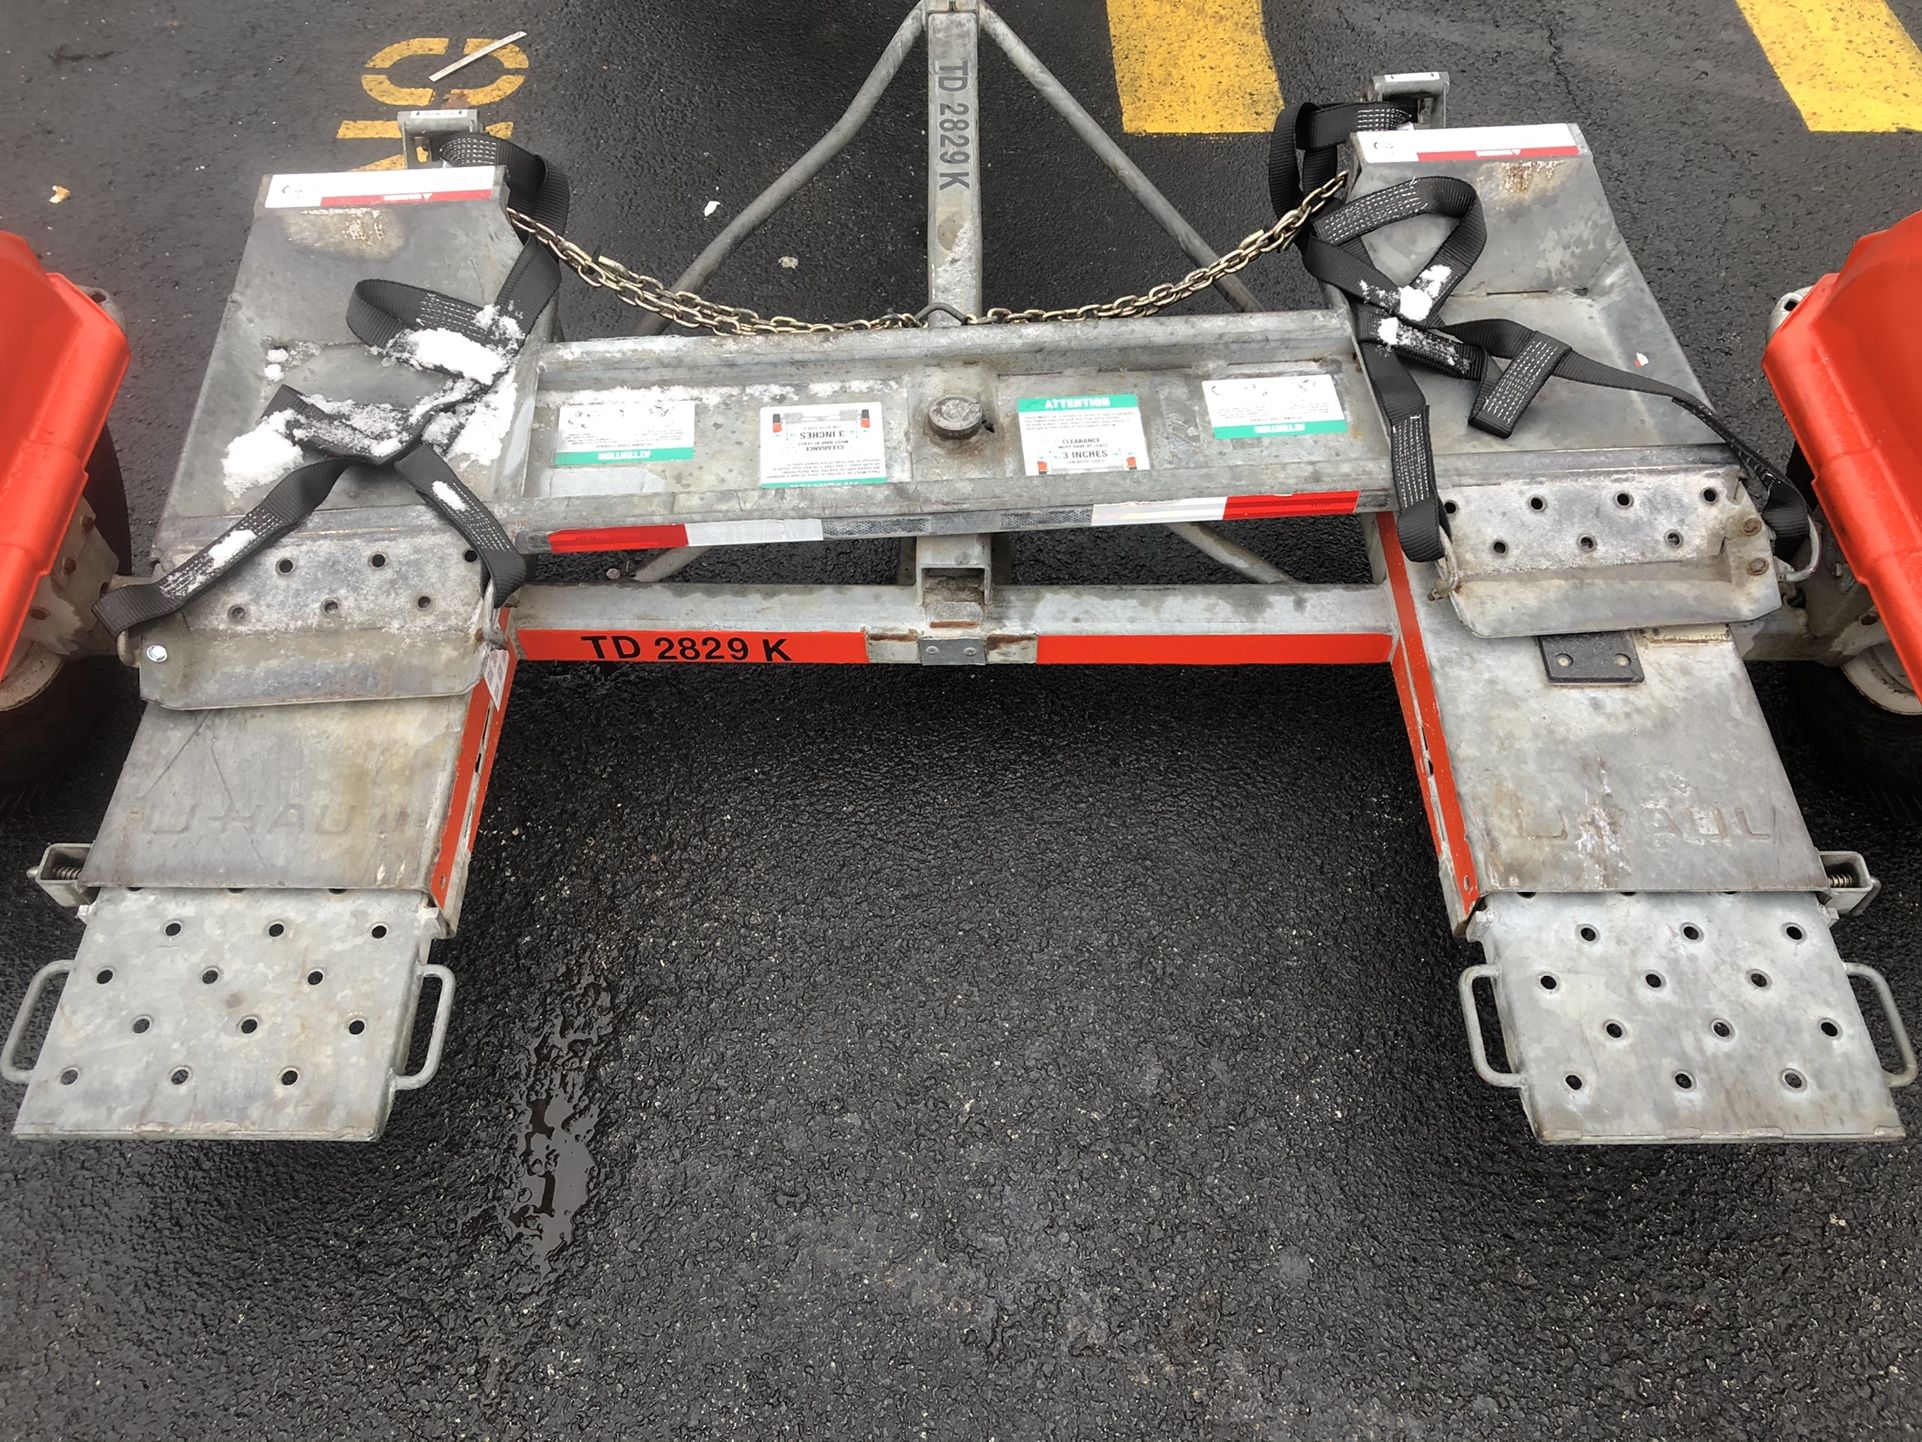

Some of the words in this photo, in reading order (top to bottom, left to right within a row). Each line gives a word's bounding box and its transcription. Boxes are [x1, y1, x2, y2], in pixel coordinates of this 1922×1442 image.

[938, 60, 969, 92] TD
[938, 102, 971, 165] 2829
[938, 171, 970, 191] K
[1044, 396, 1111, 410] ATTENTION
[799, 430, 836, 440] INCHES
[1061, 437, 1101, 445] CLEARANCE
[1071, 449, 1108, 459] INCHES
[580, 635, 641, 660] TD
[654, 636, 749, 661] 2829
[762, 638, 793, 662] K
